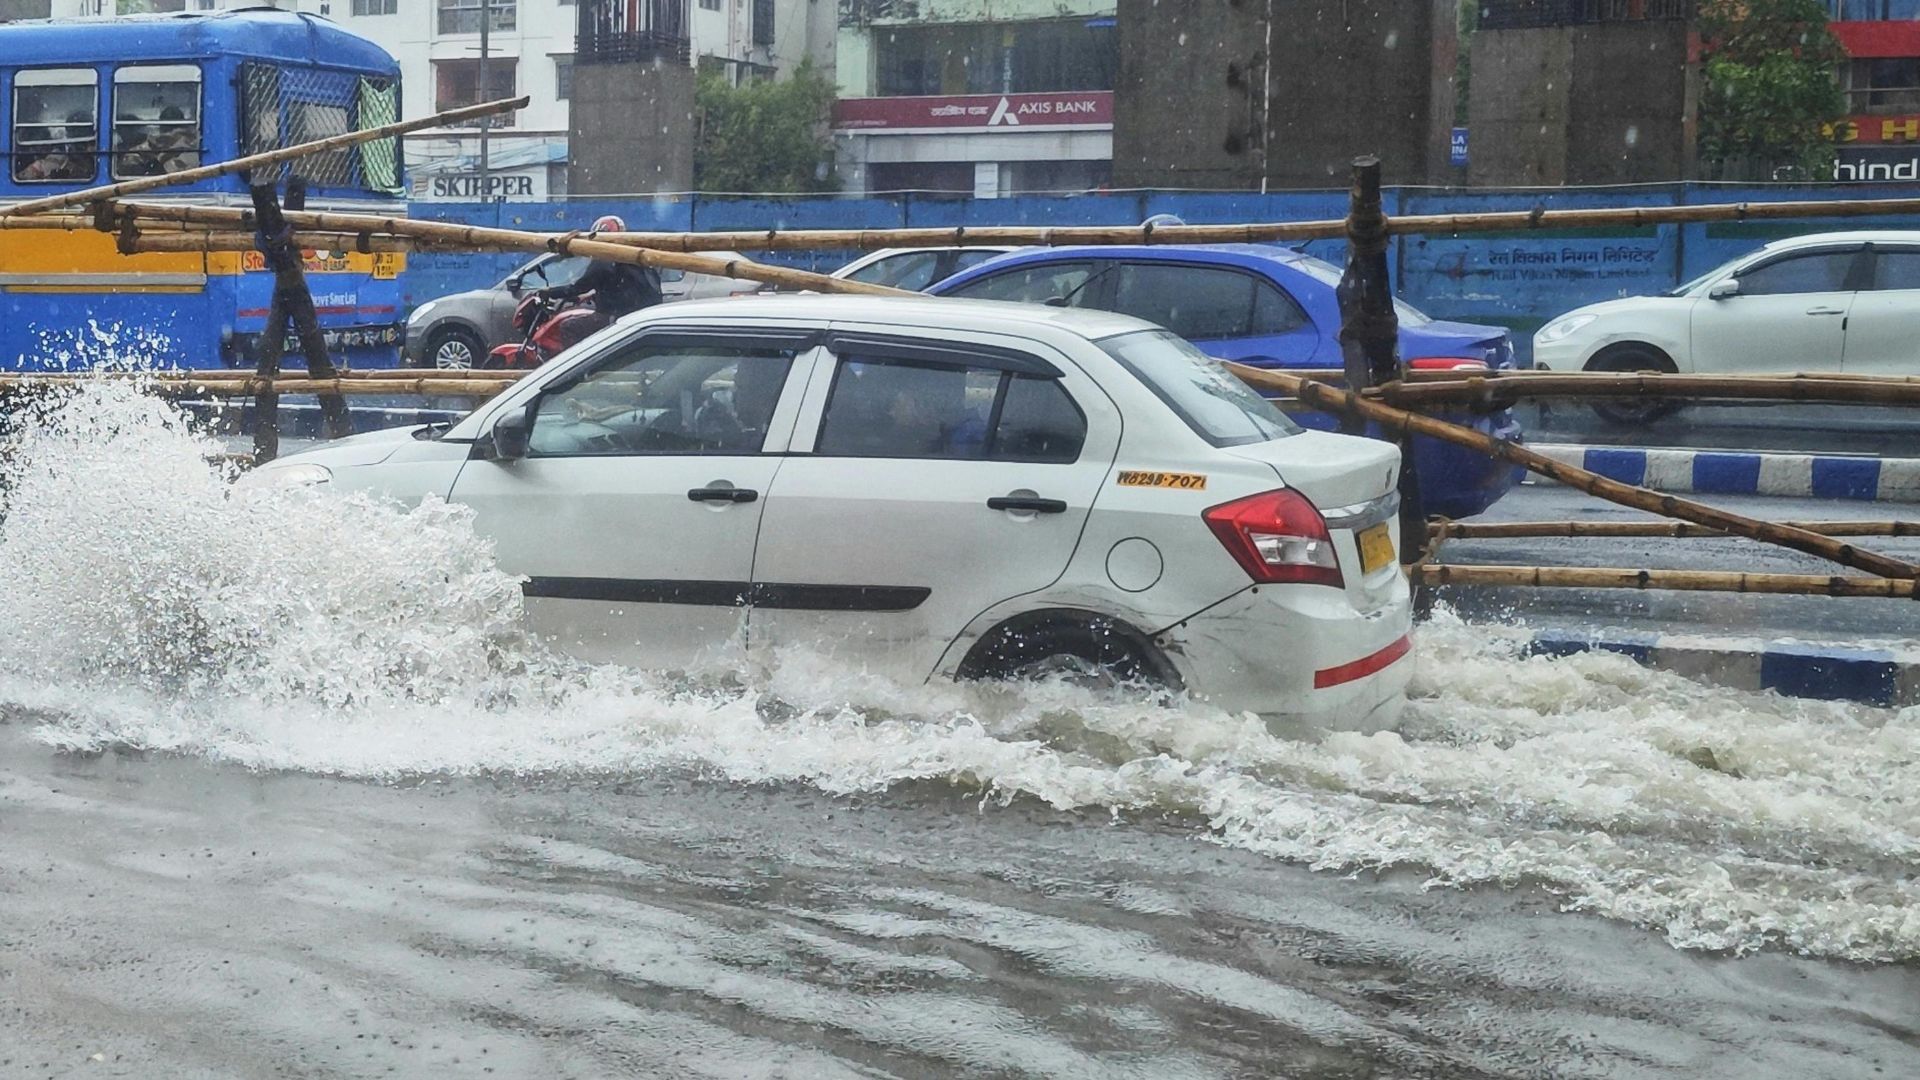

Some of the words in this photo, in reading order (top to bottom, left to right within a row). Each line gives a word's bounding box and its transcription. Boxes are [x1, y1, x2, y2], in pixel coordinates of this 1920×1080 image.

[1018, 101, 1051, 114] AXIS
[1055, 101, 1096, 113] BANK
[433, 176, 534, 198] SKIPPER
